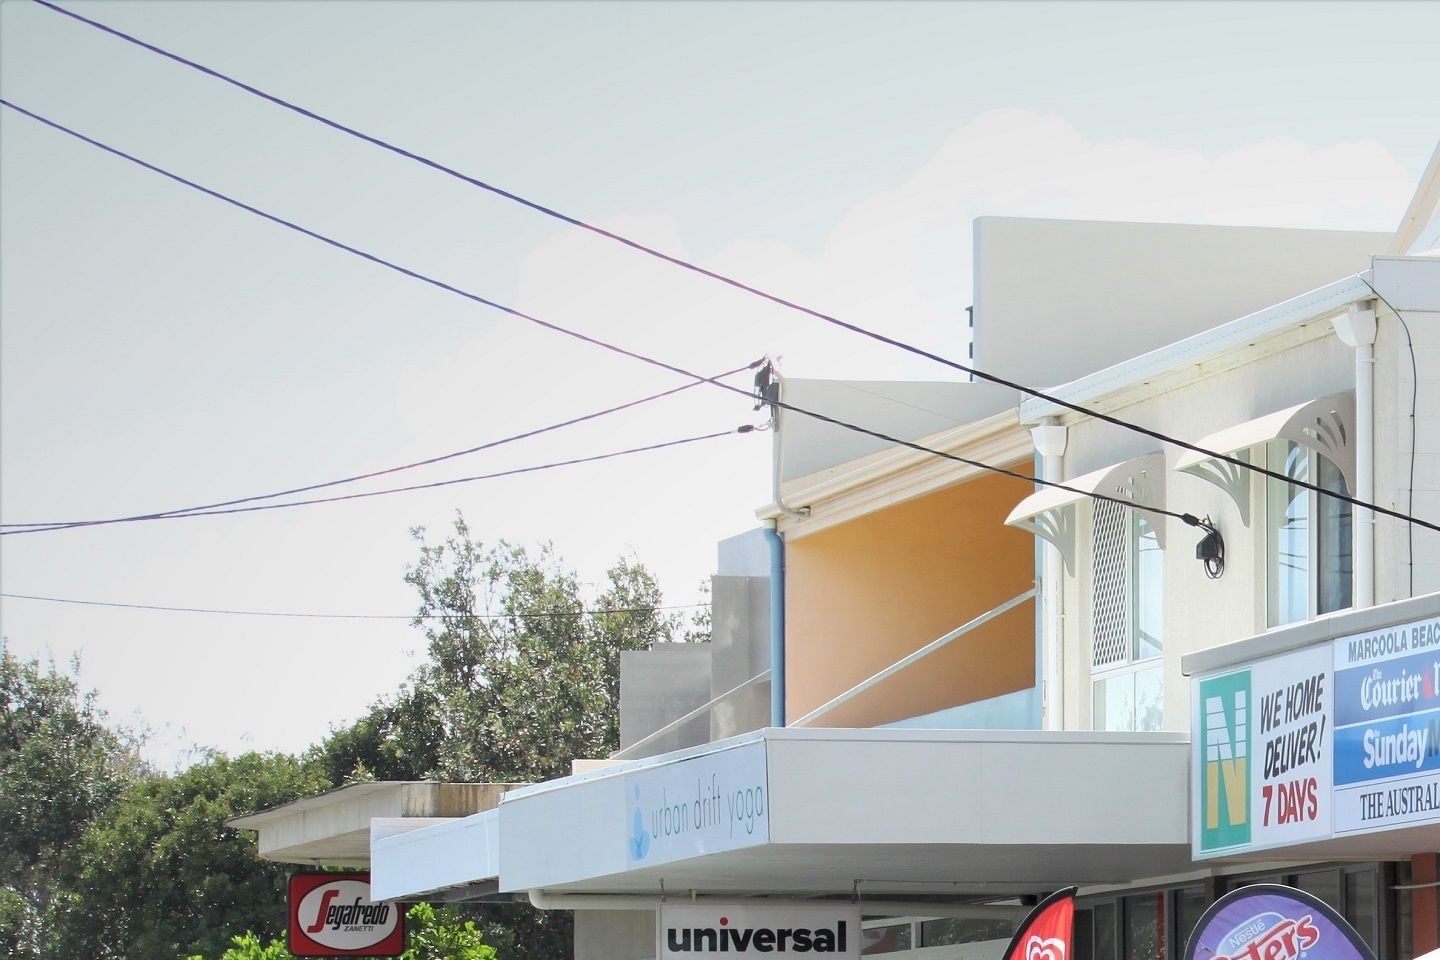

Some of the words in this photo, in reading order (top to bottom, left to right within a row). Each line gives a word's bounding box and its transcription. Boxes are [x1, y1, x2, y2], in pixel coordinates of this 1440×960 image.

[1349, 630, 1407, 662] MARCOOLA
[1261, 689, 1283, 735] WE
[1285, 673, 1325, 724] HOME
[1361, 669, 1422, 711] Courier
[1264, 714, 1326, 780] DELIVER!
[651, 787, 689, 838] urban
[693, 774, 721, 830] drift
[727, 785, 763, 839] yoga
[1263, 785, 1273, 827] 7
[1277, 777, 1318, 825] DAYS
[1360, 792, 1384, 820] THE
[307, 889, 390, 934] Segafredo
[667, 917, 846, 953] universal
[1229, 919, 1266, 949] Nestlé
